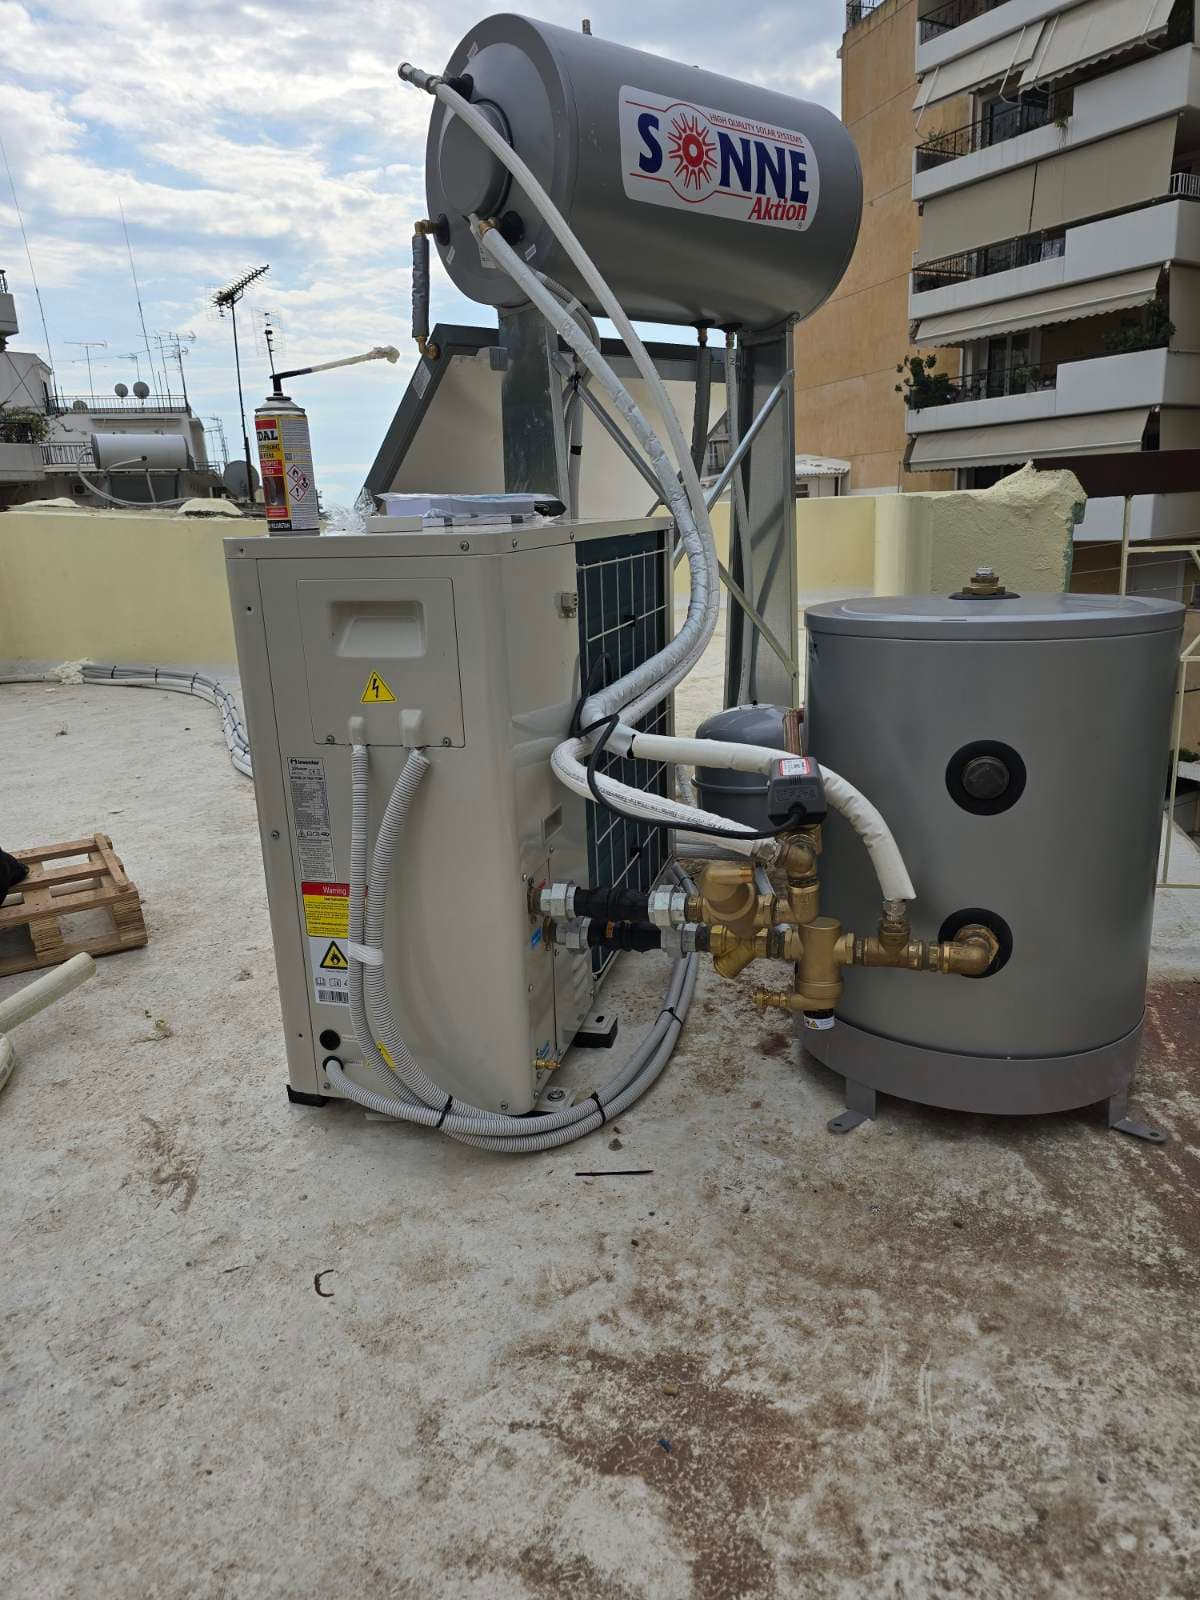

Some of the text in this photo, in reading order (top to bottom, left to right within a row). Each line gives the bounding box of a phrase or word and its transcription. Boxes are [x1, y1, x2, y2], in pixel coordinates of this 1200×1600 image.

[709, 113, 803, 144] HIGH QUALITY SOLAR SYSTEMS
[748, 197, 808, 221] Aktion
[322, 885, 347, 896] Warning
